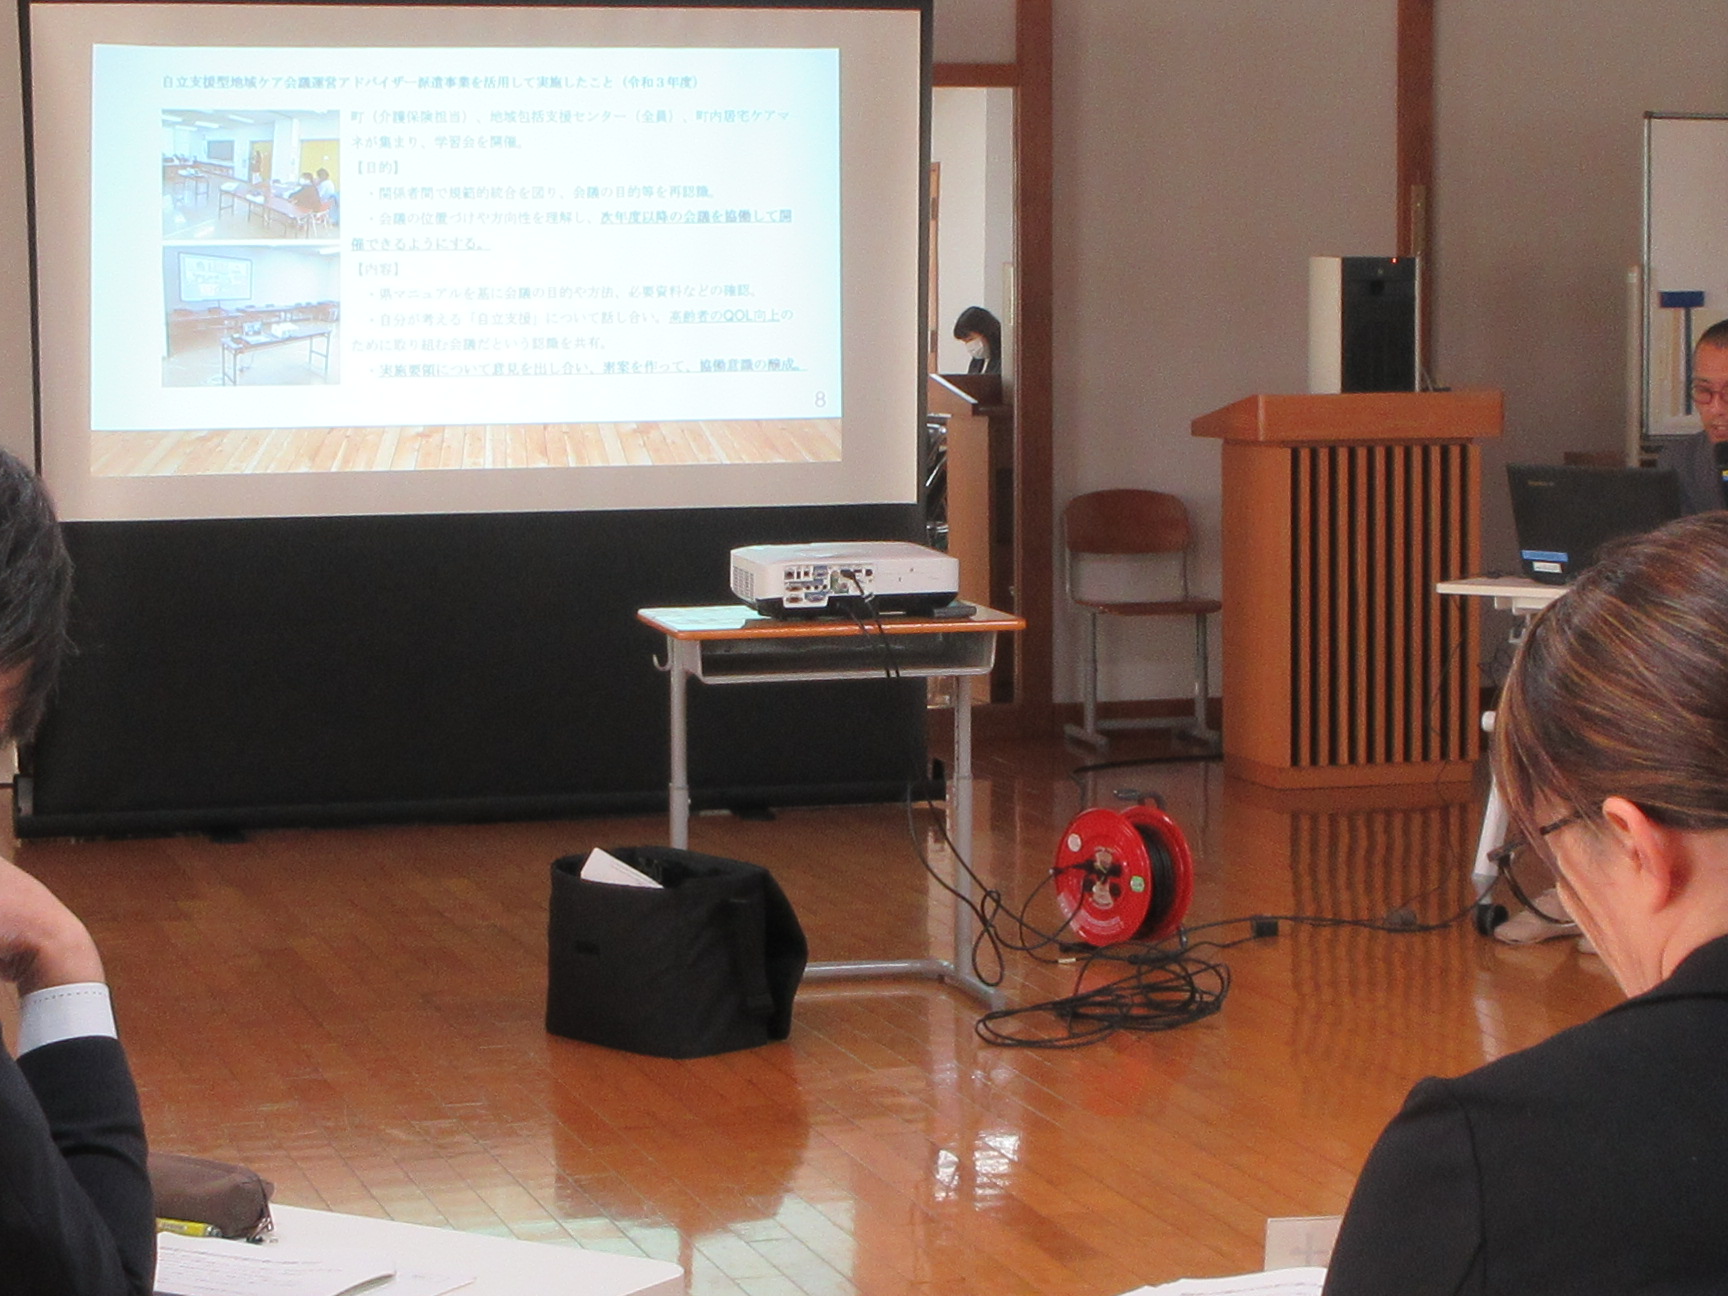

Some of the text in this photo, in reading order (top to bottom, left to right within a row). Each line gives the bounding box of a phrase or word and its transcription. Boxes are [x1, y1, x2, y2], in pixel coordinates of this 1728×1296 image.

[356, 160, 399, 175] 【目的】
[356, 261, 399, 276] 【内容】
[814, 390, 827, 408] 8
